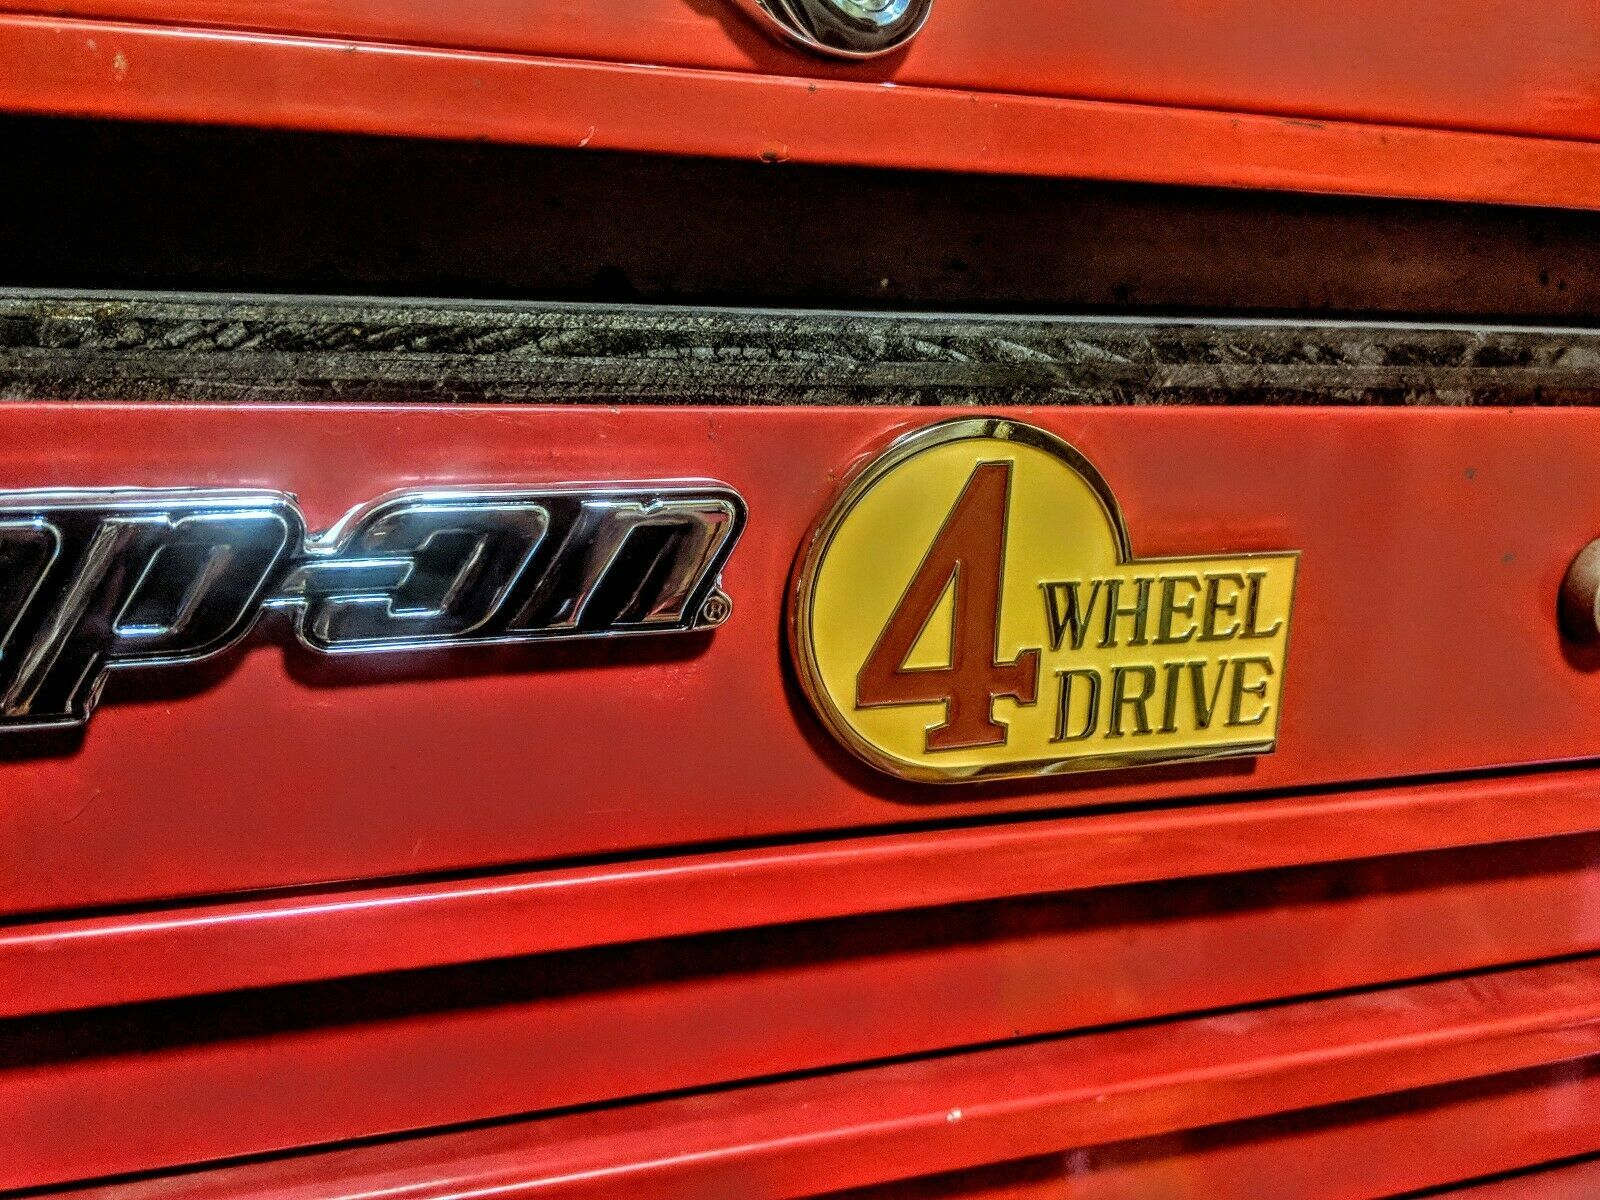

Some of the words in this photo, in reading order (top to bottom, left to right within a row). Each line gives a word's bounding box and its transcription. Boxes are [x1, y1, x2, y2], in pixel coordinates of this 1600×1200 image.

[855, 459, 1041, 752] 4
[1038, 571, 1283, 652] WHEEL
[1049, 656, 1275, 743] DRIVE
